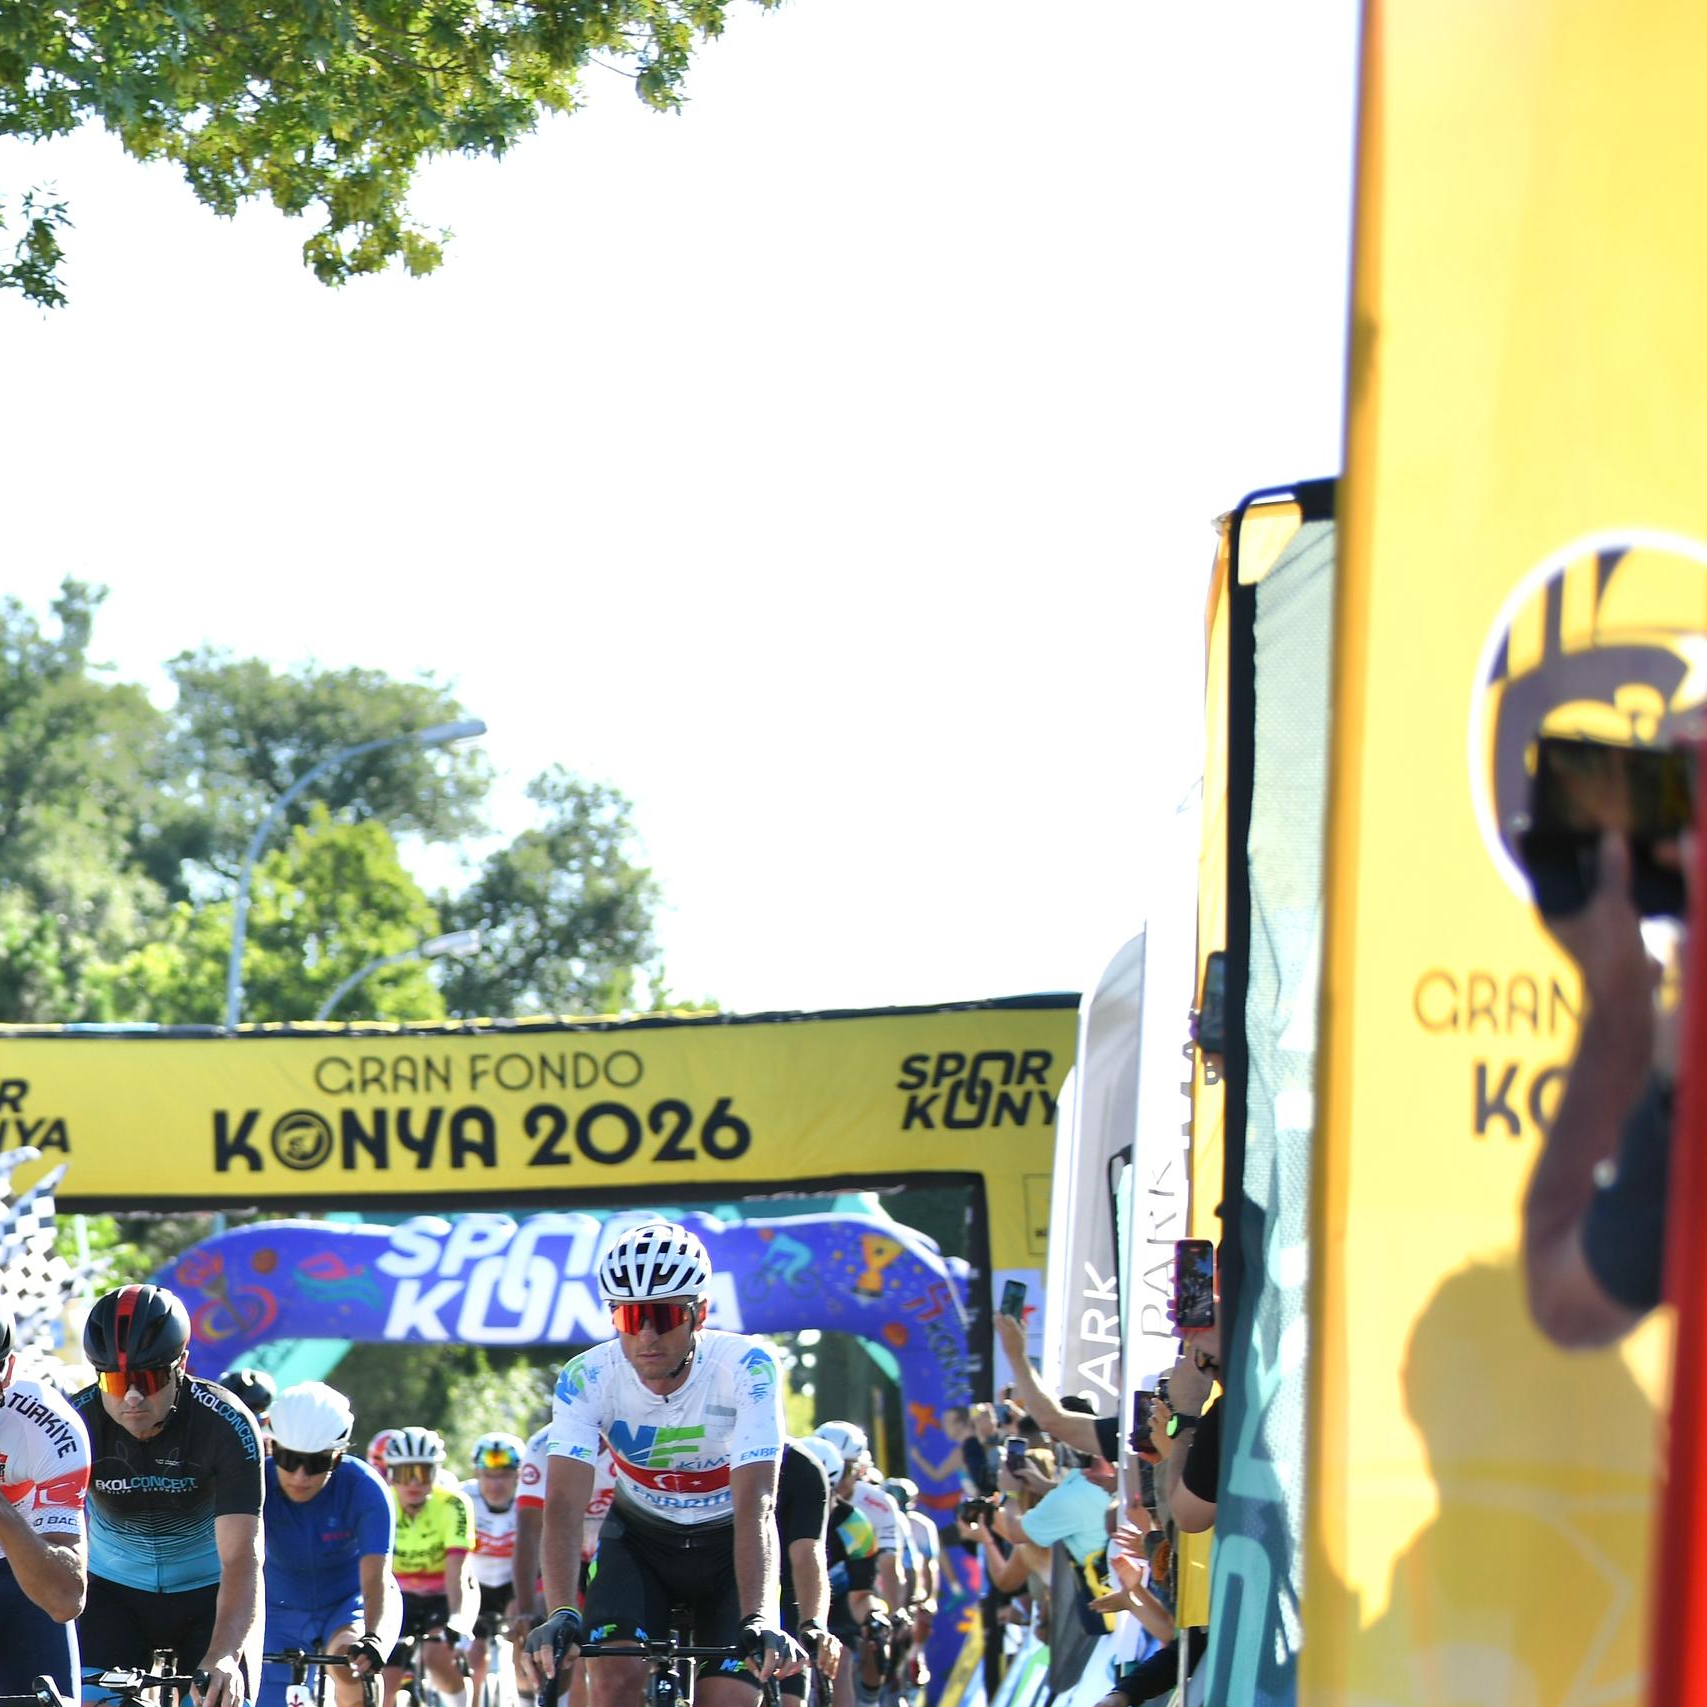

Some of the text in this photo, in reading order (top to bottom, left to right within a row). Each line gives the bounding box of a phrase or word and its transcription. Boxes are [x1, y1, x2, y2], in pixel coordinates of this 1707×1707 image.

[314, 1050, 643, 1095] GRAN FONDO
[896, 1048, 1054, 1106] SPOR
[214, 1098, 752, 1173] KONYA 2026
[902, 1085, 1058, 1132] KONY
[383, 1256, 744, 1343] KONA
[7, 1392, 78, 1459] TÜRKİYE
[190, 1382, 259, 1461] EKOLCONCEPT
[96, 1475, 199, 1492] EKOLCONCEPT
[740, 1447, 781, 1463] ENBR
